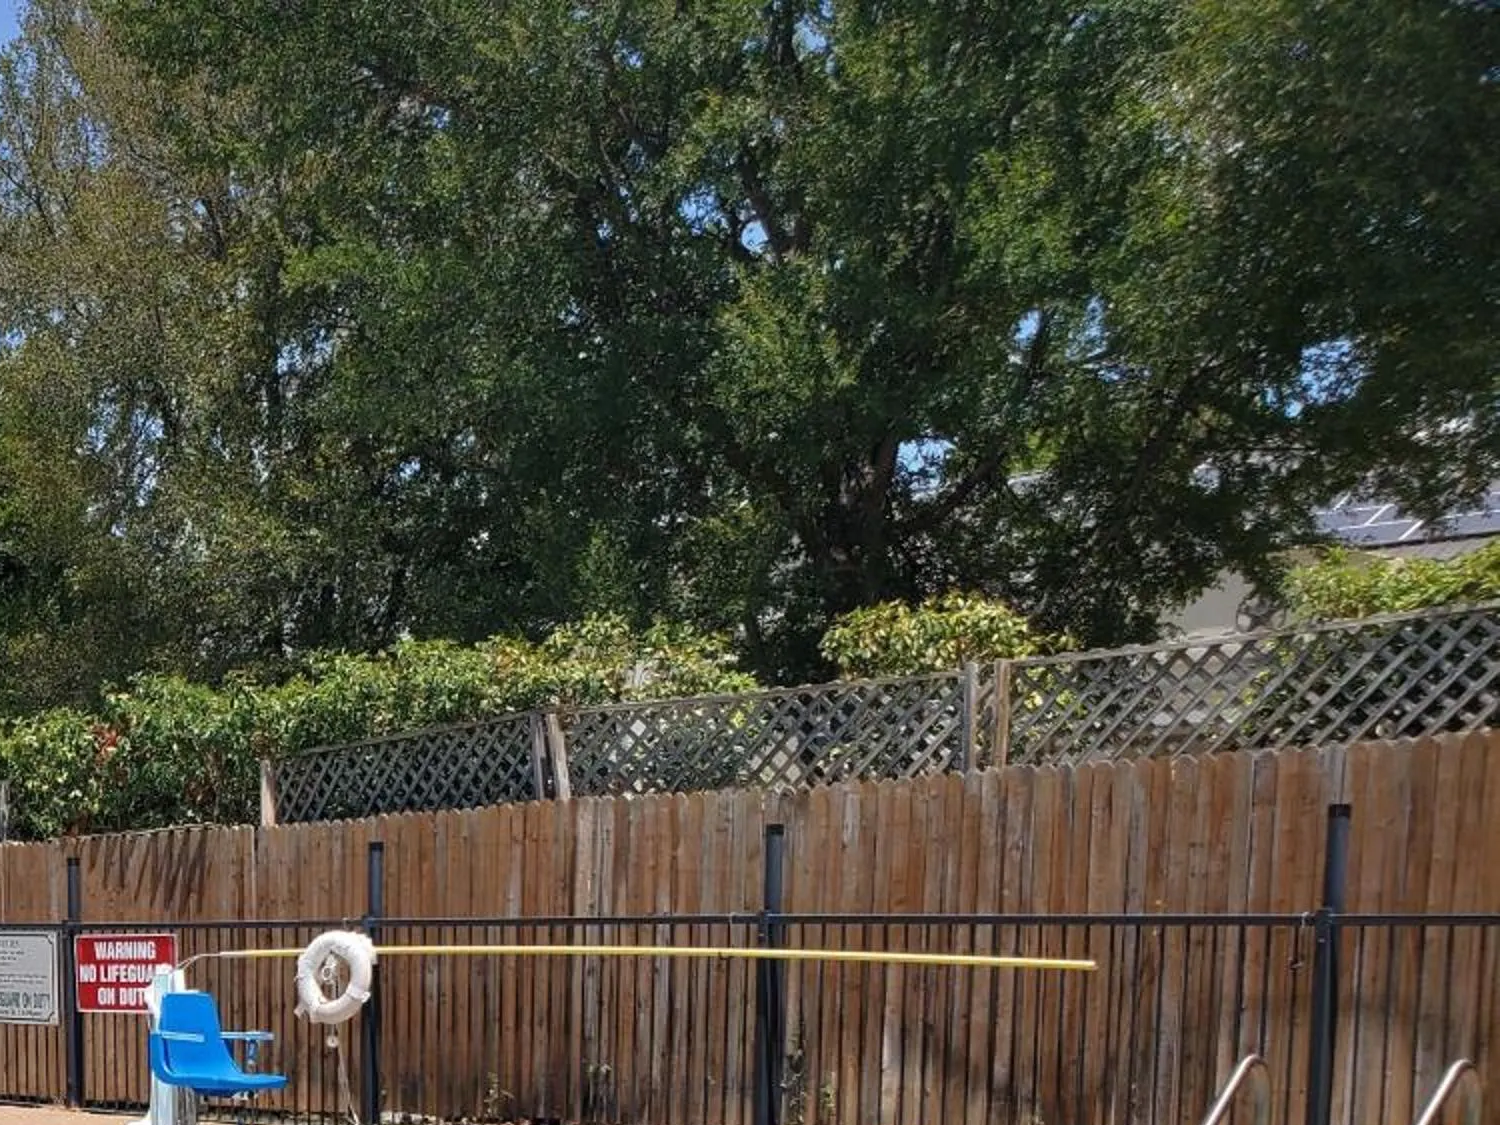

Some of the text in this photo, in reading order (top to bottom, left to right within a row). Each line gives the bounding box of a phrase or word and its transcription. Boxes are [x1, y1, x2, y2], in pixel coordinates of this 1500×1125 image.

[94, 941, 156, 960] WARNING
[79, 963, 154, 983] NO LIFEGUA
[97, 987, 145, 1006] ON DUT
